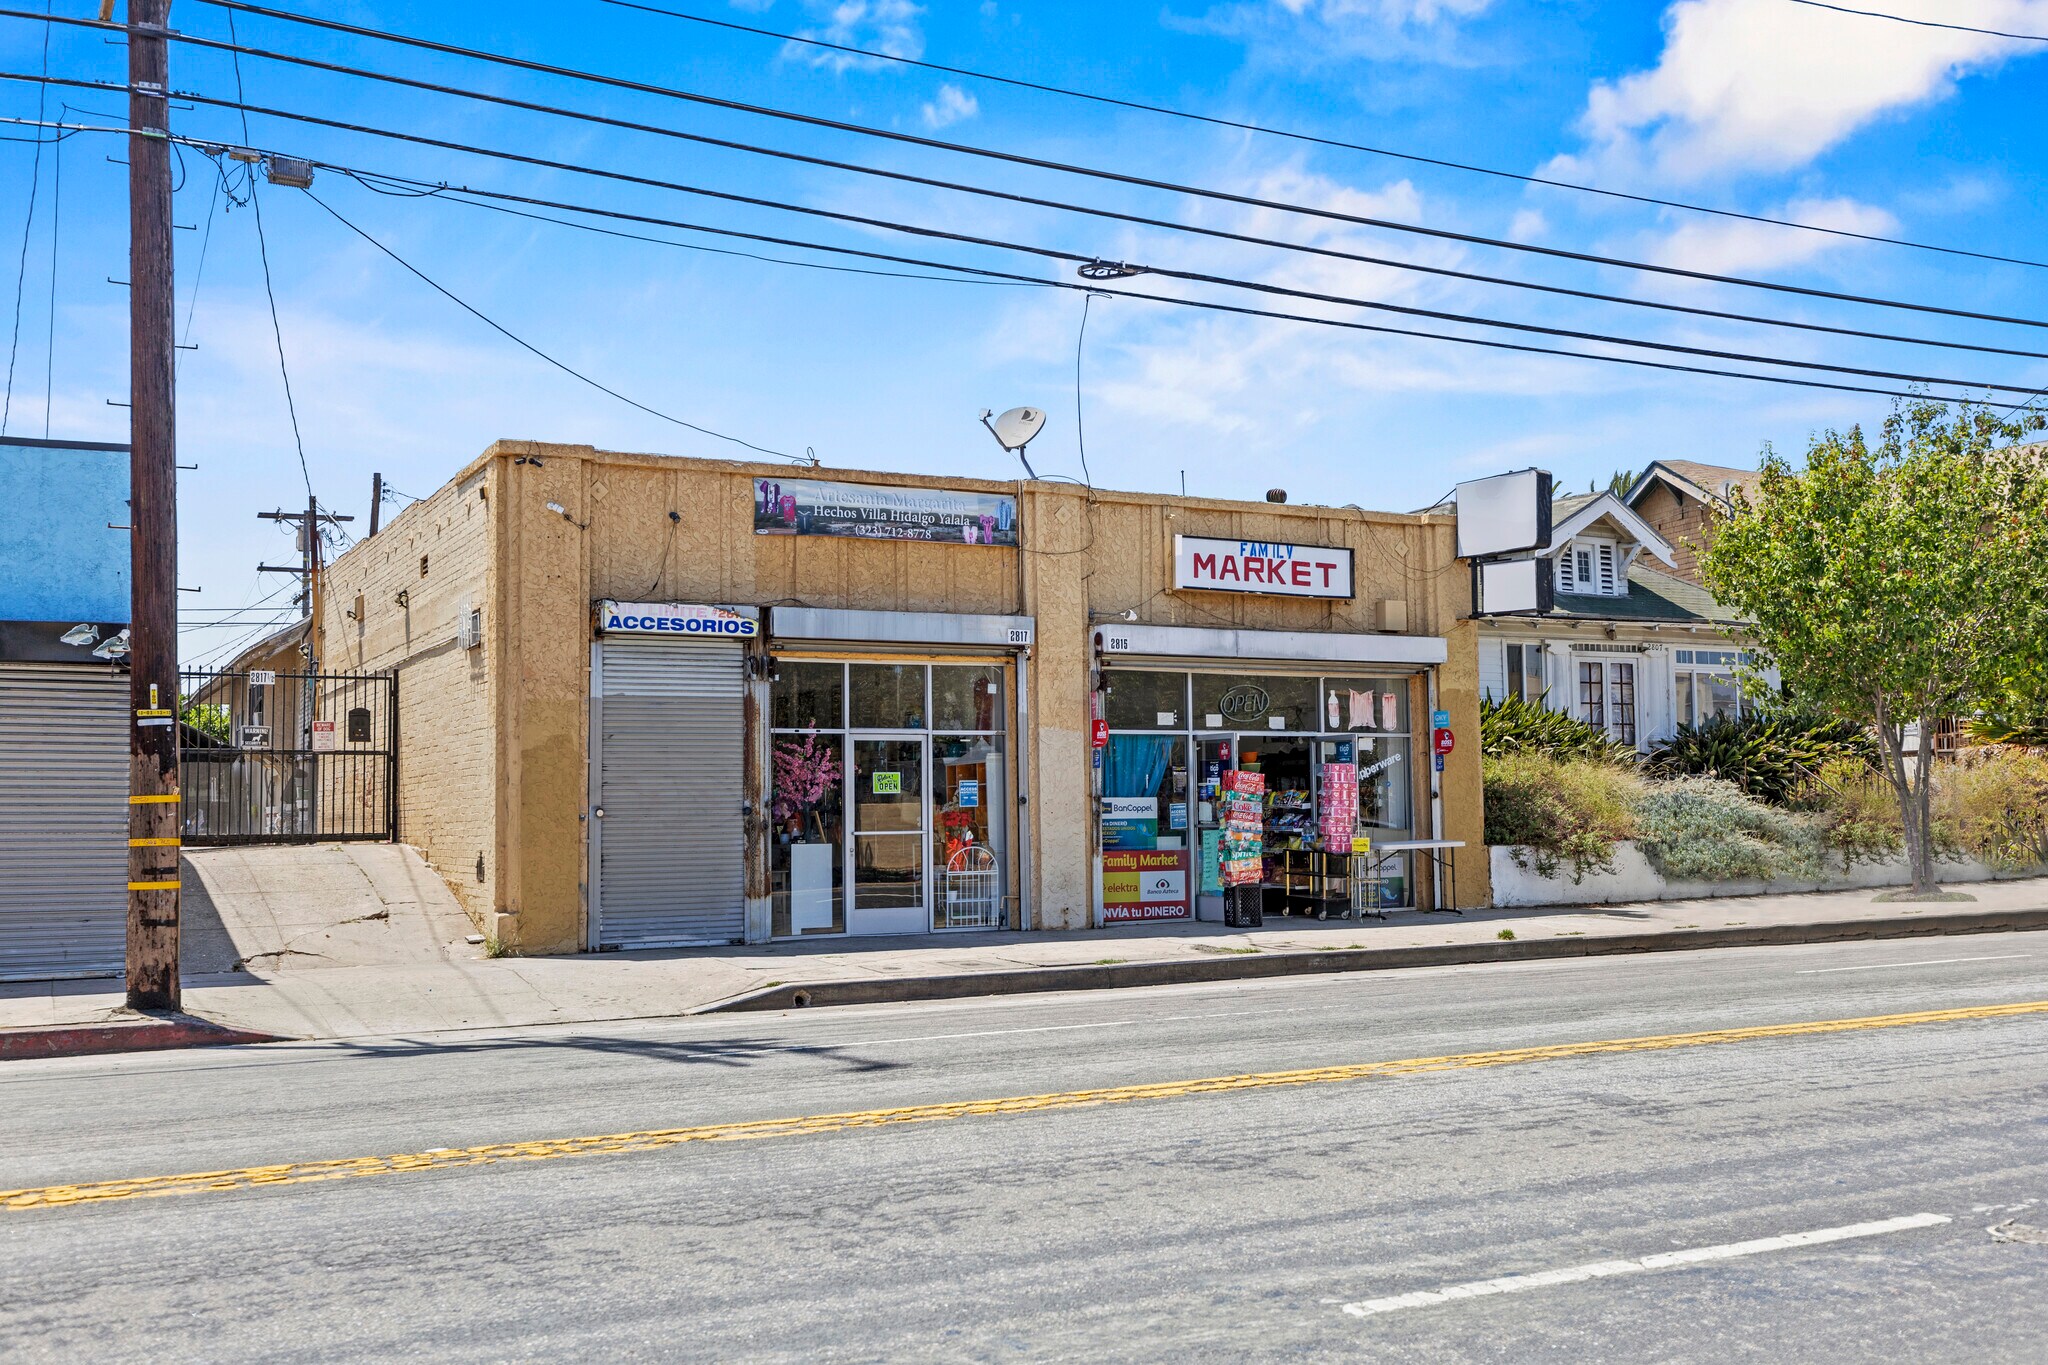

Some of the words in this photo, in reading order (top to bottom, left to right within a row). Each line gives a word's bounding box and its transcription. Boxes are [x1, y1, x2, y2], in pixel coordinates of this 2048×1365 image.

[814, 487, 887, 506] Artesania
[892, 493, 966, 513] Margarita
[814, 505, 857, 519] Hechos
[860, 508, 887, 521] Villa
[890, 510, 935, 527] Hidalgo
[939, 513, 970, 526] Yalala
[855, 525, 882, 537] (323)
[884, 527, 932, 539] 712-8778
[1193, 553, 1337, 588] MARKET
[607, 615, 755, 634] ACCESORIOS
[1010, 630, 1028, 642] 2817
[1110, 638, 1128, 650] 2815
[1647, 643, 1663, 651] 2807
[1223, 694, 1265, 713] OPEN
[879, 783, 898, 791] OPEN
[1113, 804, 1154, 813] BanCoppel
[1233, 802, 1253, 810] Coke
[1103, 854, 1137, 869] Family
[1140, 854, 1179, 866] Market
[1107, 882, 1139, 893] elektra
[1103, 905, 1130, 918] NVÍA
[1131, 908, 1142, 918] tu
[1144, 905, 1185, 917] DINERO
